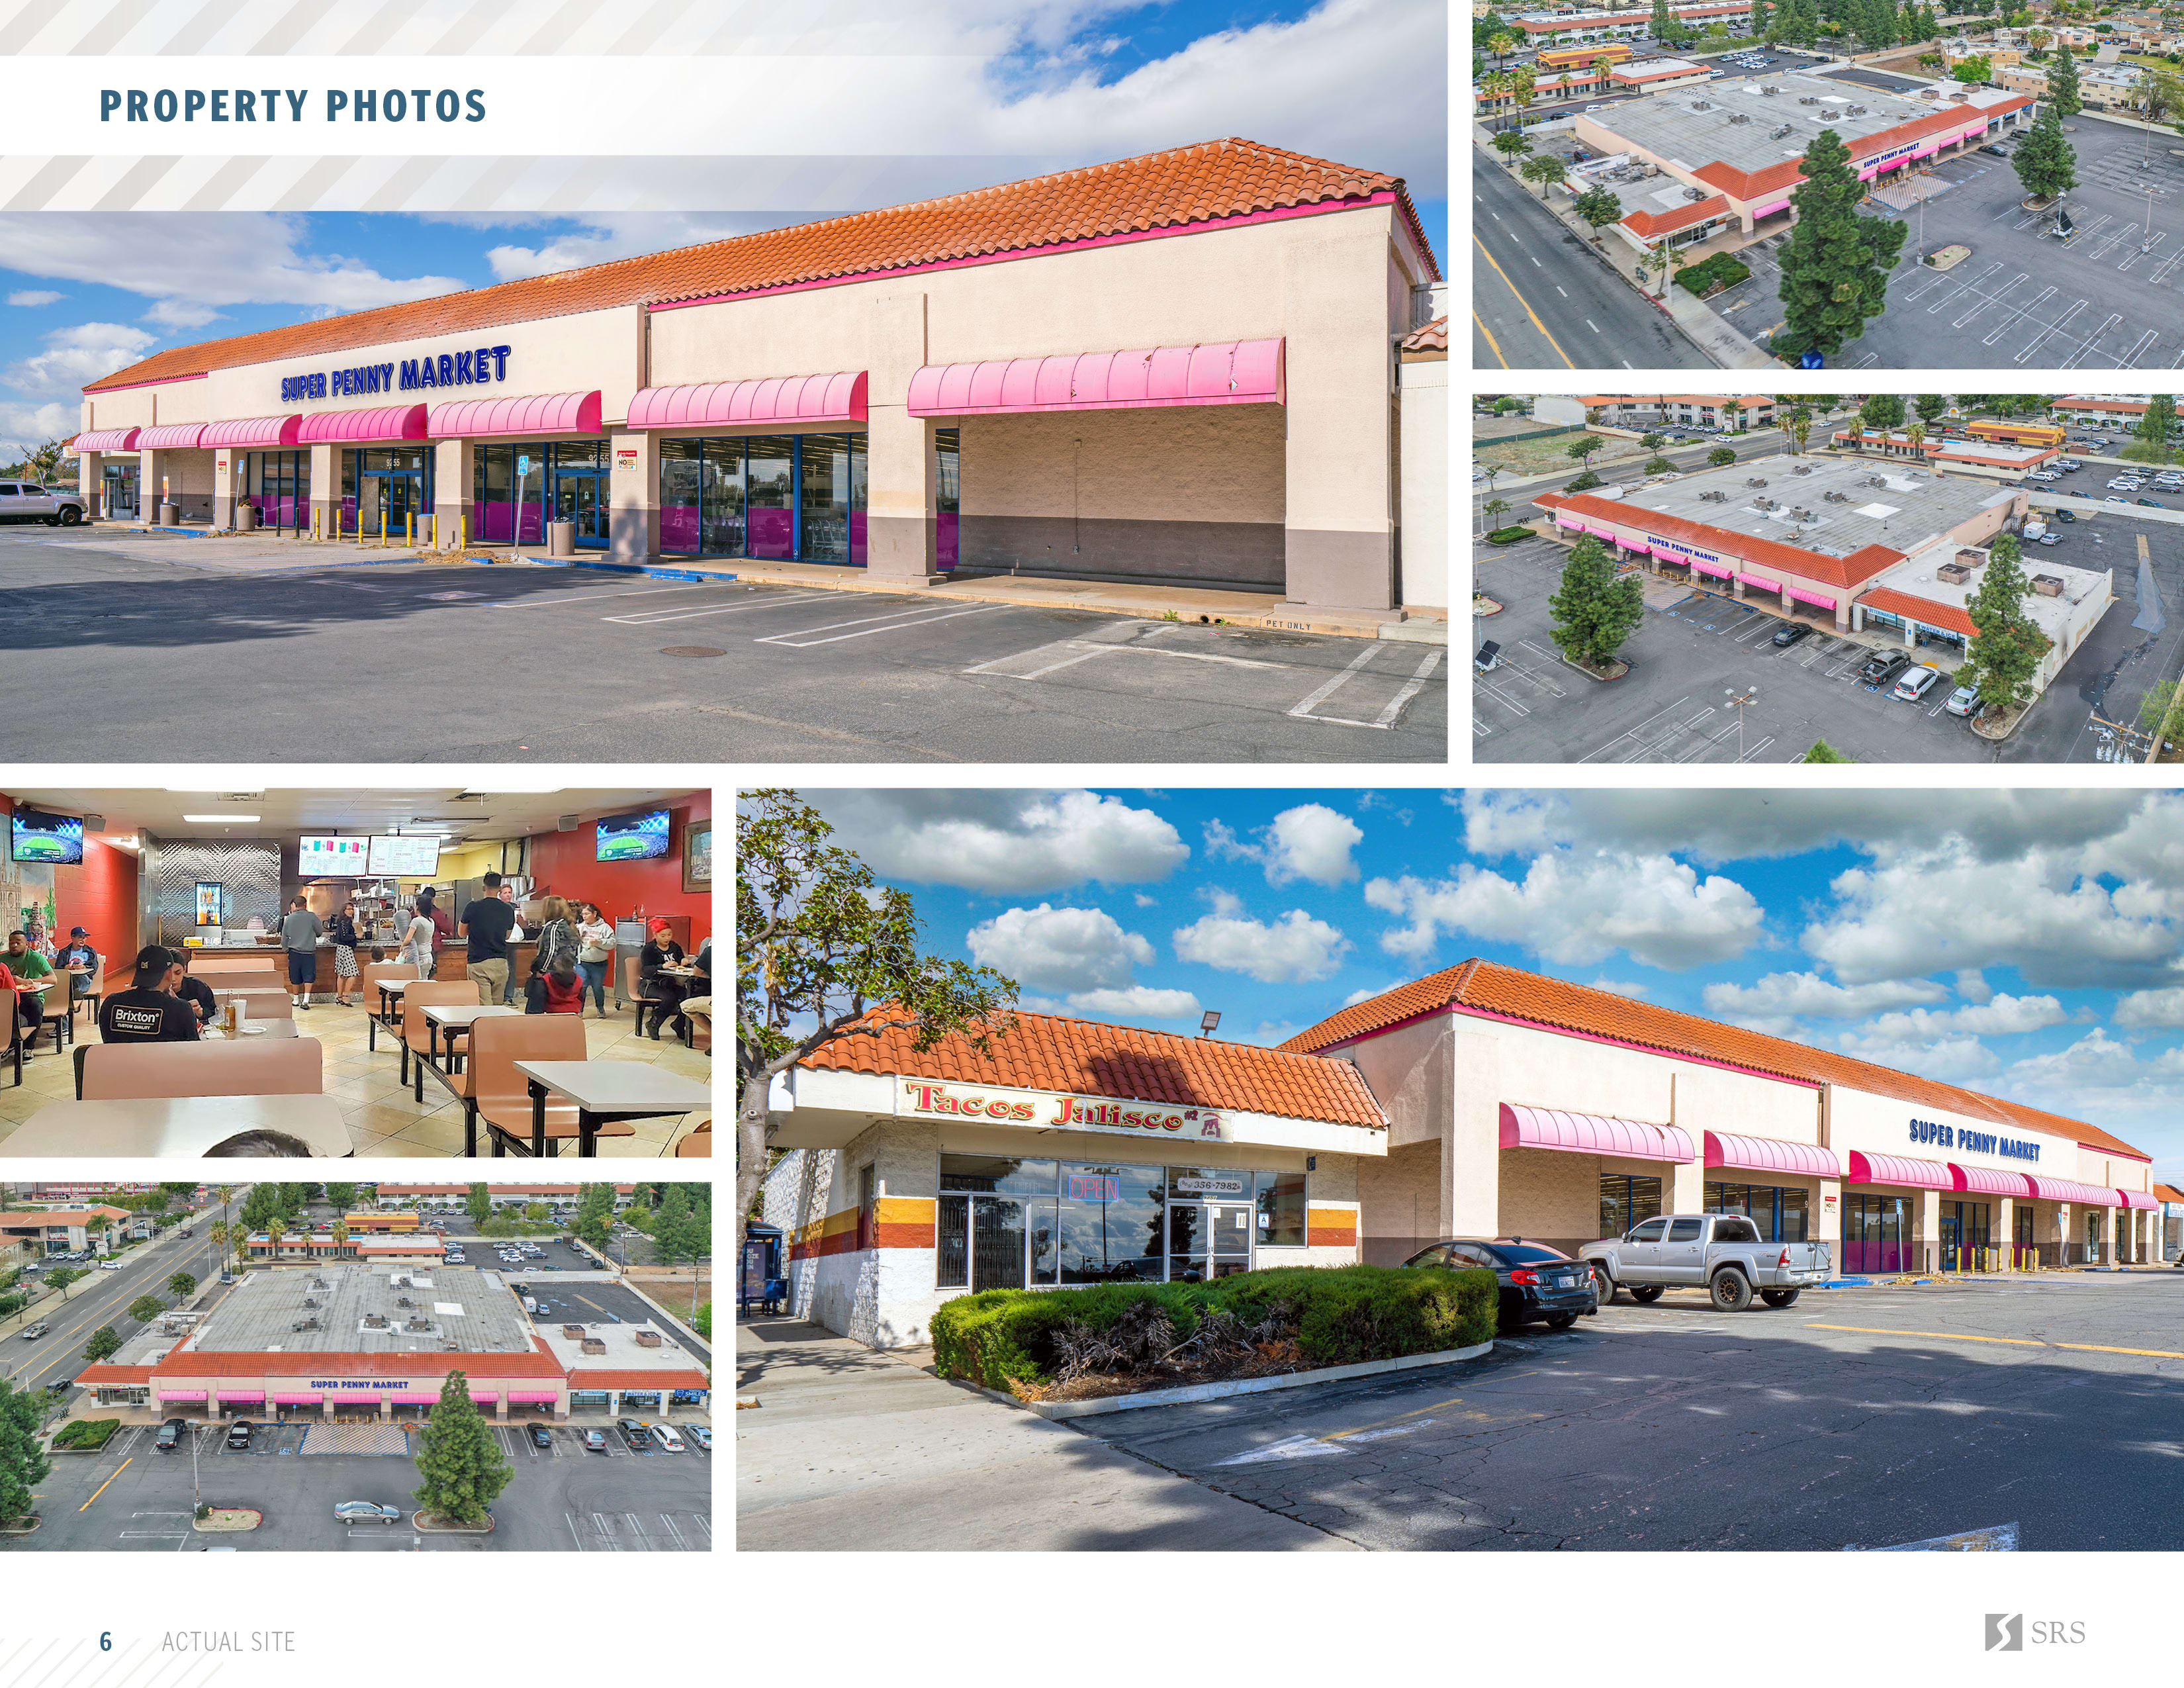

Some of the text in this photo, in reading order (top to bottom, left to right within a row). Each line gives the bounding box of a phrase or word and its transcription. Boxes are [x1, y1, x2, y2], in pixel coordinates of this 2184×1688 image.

[1863, 142, 1920, 167] SUPER PENNY MARKET
[281, 344, 511, 402] SUPER PENNY MARKET
[1647, 536, 1719, 563] SUPER PENNY MARKET
[1921, 625, 1940, 635] WATER
[115, 1009, 156, 1023] Brixton
[906, 1081, 1035, 1120] Tacos
[1051, 1096, 1198, 1131] Jalisco #2
[1909, 1119, 2040, 1162] SUPER PENNY MARKET
[1071, 1178, 1117, 1199] OPEN
